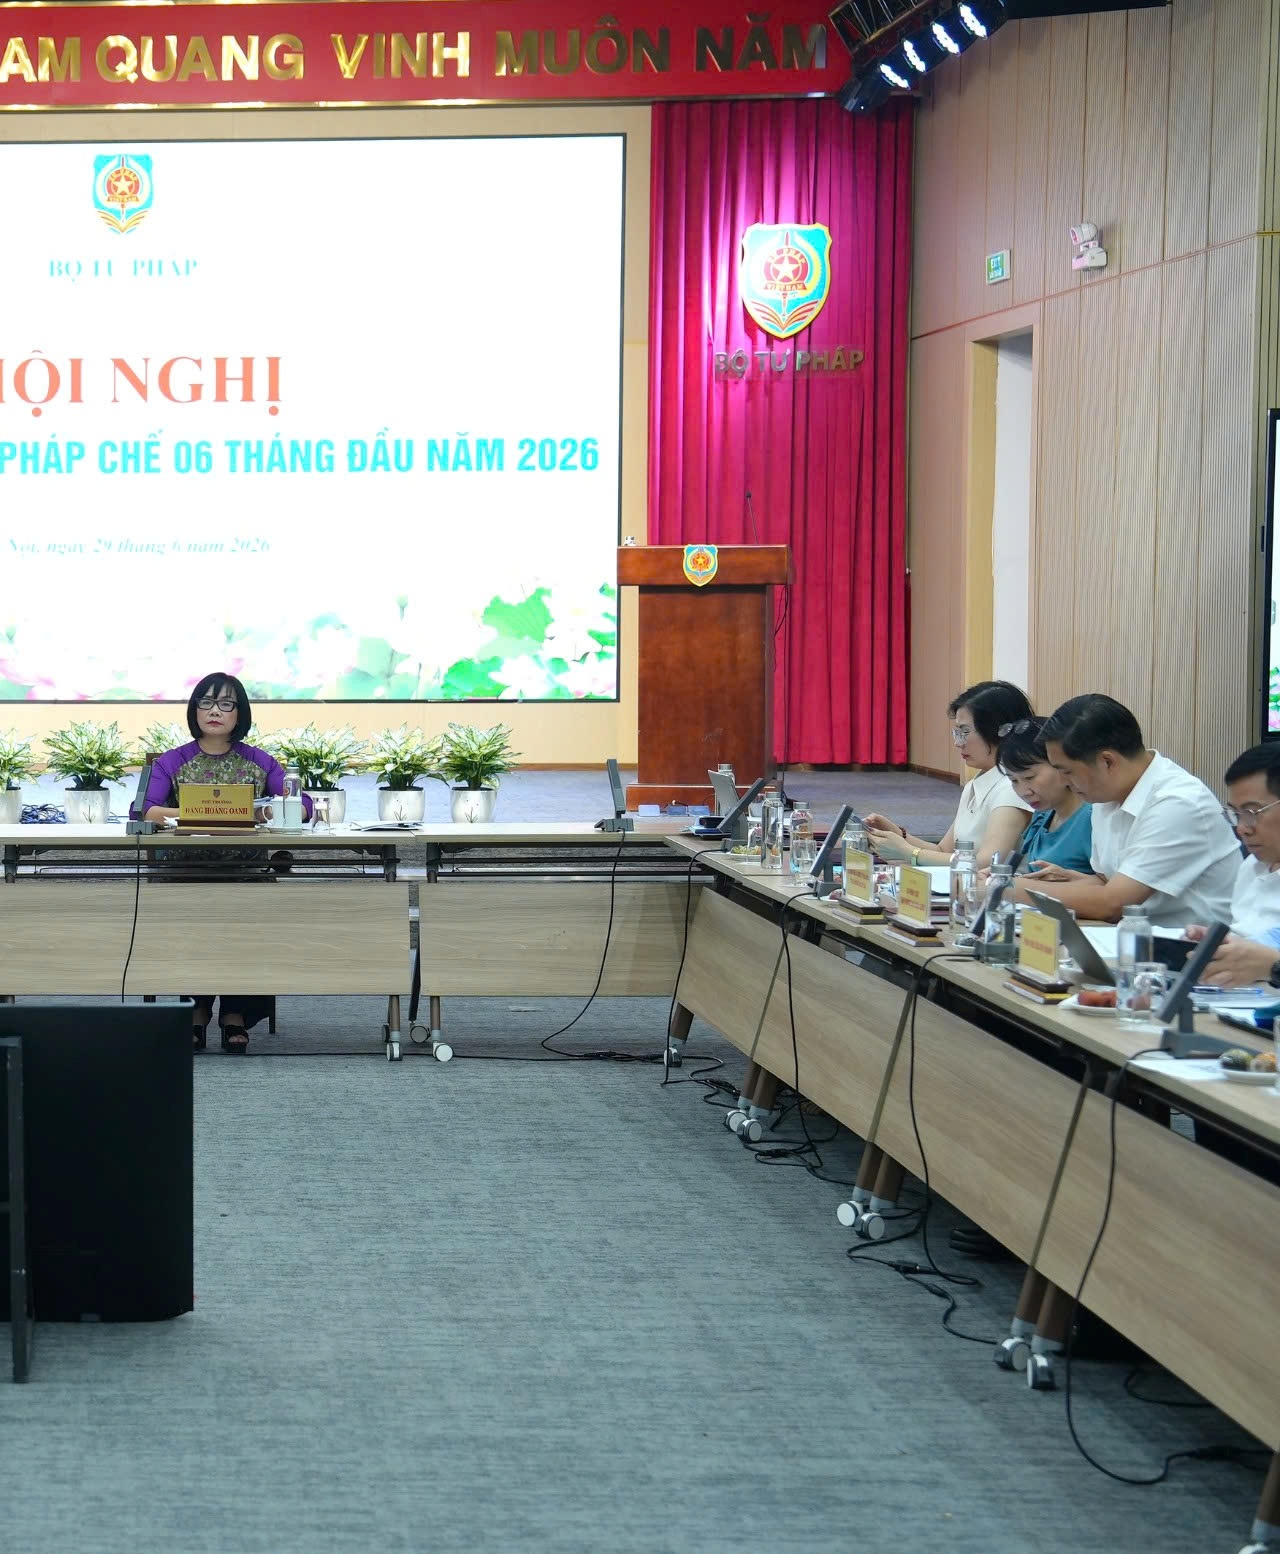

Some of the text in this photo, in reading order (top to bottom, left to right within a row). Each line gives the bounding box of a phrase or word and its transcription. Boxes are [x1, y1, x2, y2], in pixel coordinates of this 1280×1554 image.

[95, 34, 304, 85] QUANG
[331, 31, 470, 80] VINH
[496, 19, 670, 76] MUÔN
[695, 12, 826, 72] NĂM
[715, 345, 864, 378] BỘ TƯ PHÁP
[111, 356, 282, 417] NGHỊ
[98, 429, 162, 475] CHẾ
[173, 440, 213, 475] 06
[224, 432, 335, 474] THÁNG
[347, 427, 415, 473] ĐẦU
[427, 431, 505, 473] NĂM
[517, 437, 600, 473] 2026
[229, 807, 248, 815] OANH
